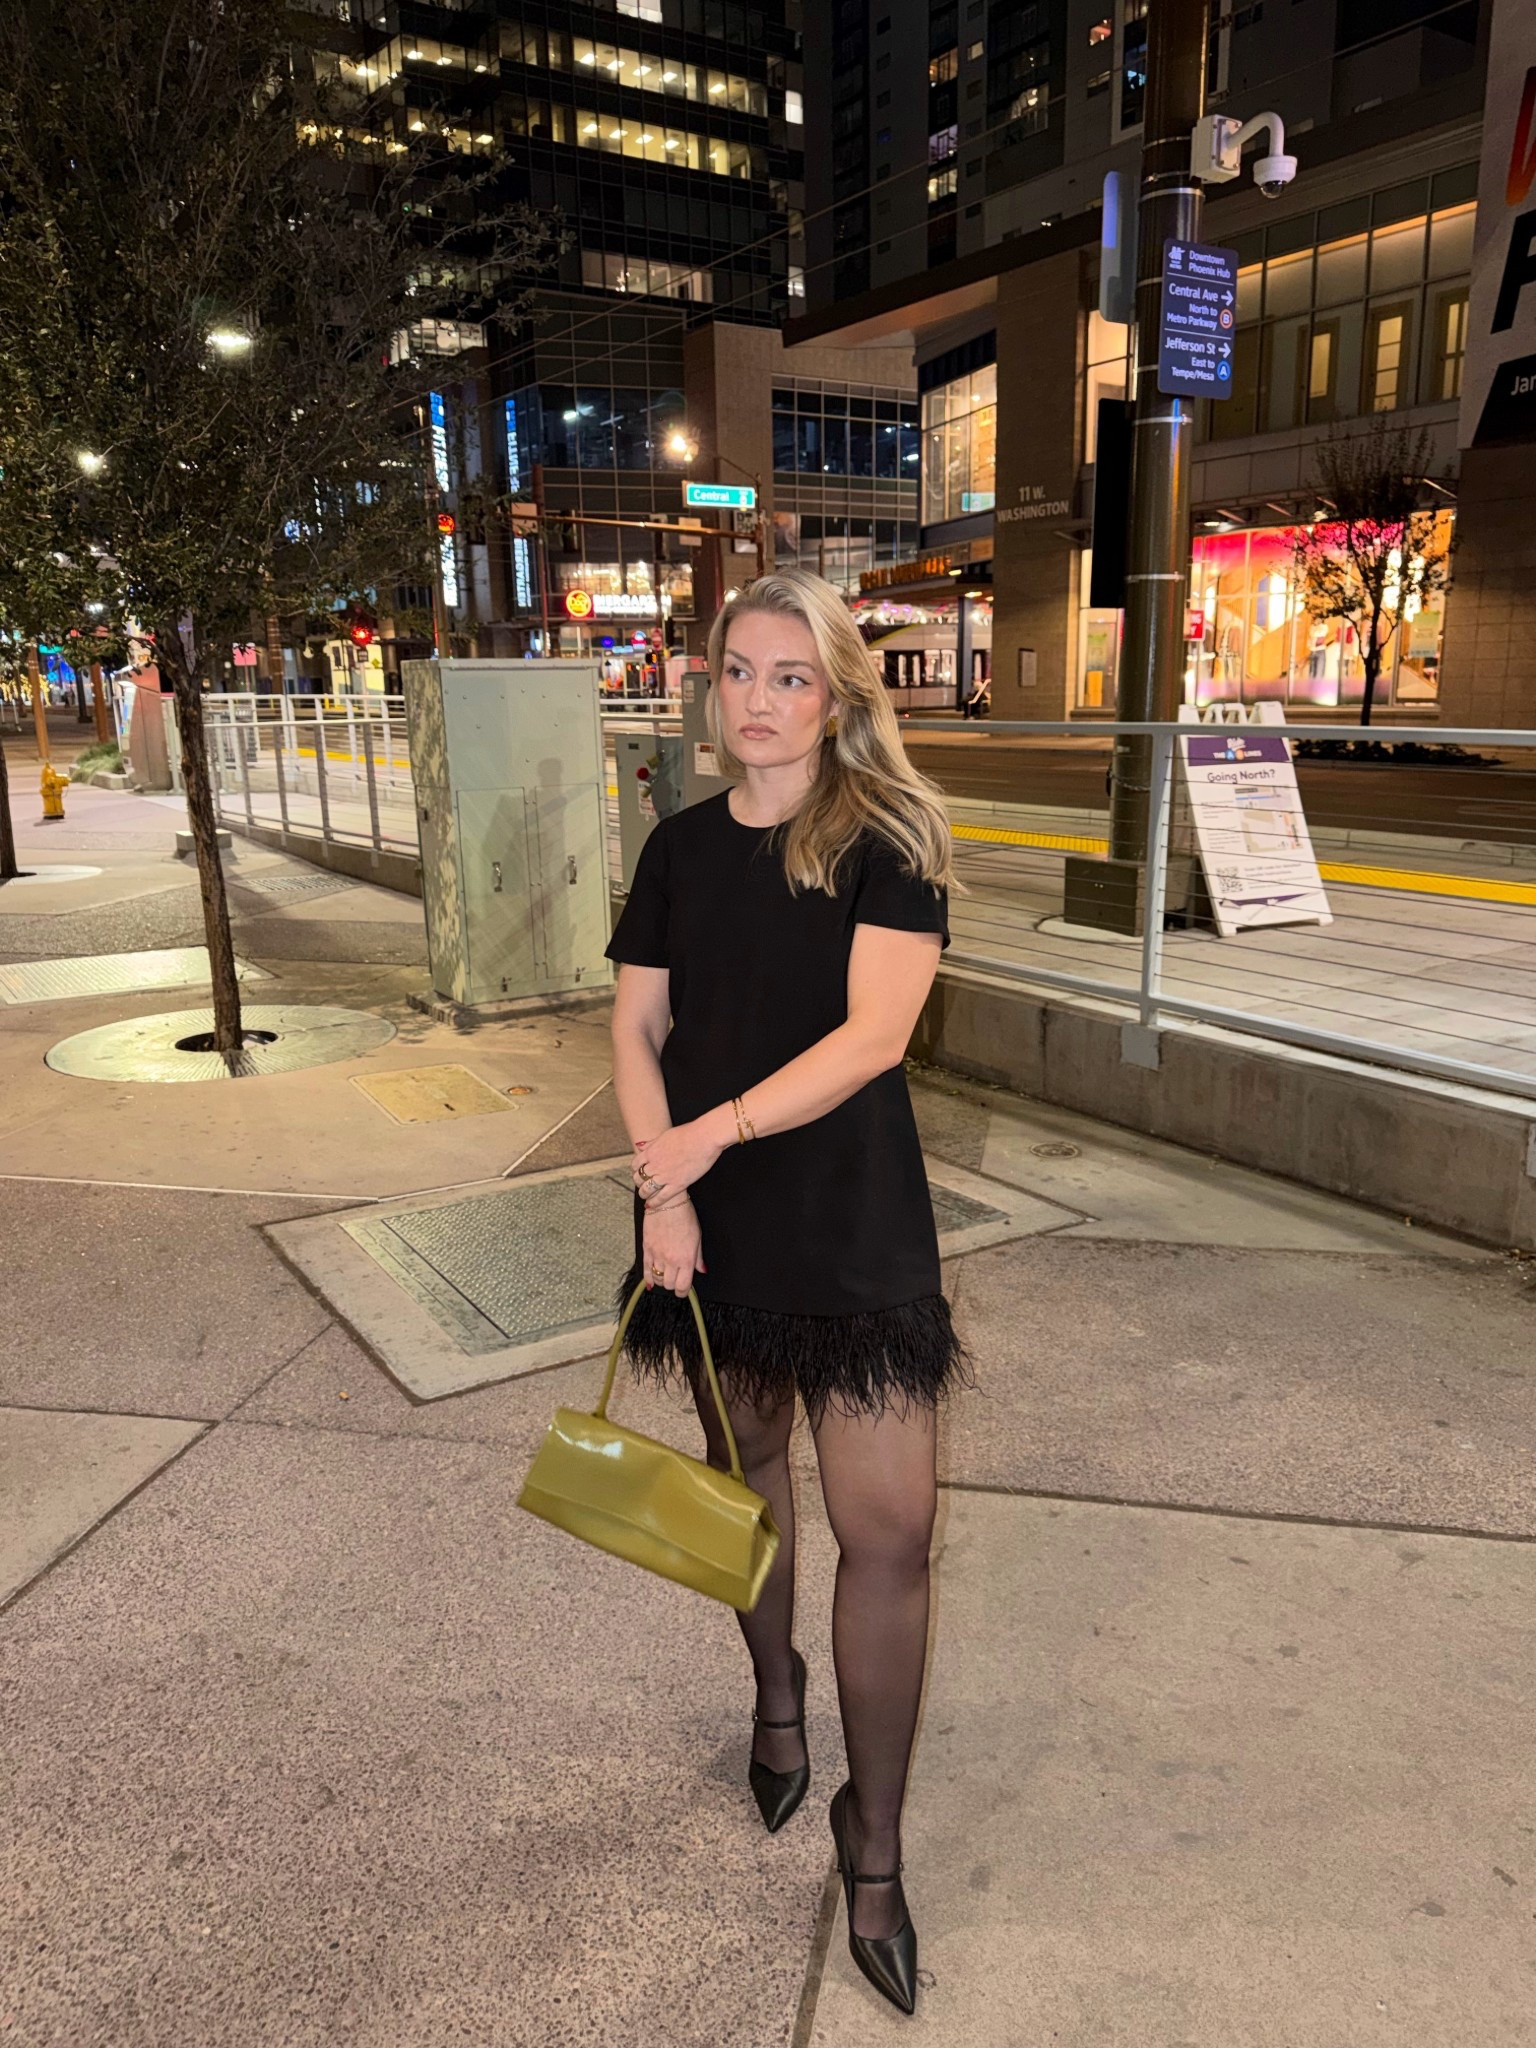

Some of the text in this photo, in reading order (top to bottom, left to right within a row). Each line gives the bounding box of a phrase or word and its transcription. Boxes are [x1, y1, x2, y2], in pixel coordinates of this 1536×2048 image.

[1189, 250, 1225, 265] Downtown
[1189, 262, 1230, 278] Phoenix Hub
[1169, 283, 1218, 302] Central Ave
[1189, 303, 1218, 317] North to
[1167, 312, 1218, 331] Metro Parkway
[1165, 337, 1216, 355] Jefferson St
[1191, 356, 1216, 369] East to
[1171, 366, 1214, 381] Tempe/Mesa
[693, 489, 730, 502] Central
[1019, 486, 1046, 502] 11 W.
[997, 500, 1069, 523] WASHINGTON
[1207, 769, 1275, 784] Going North?
